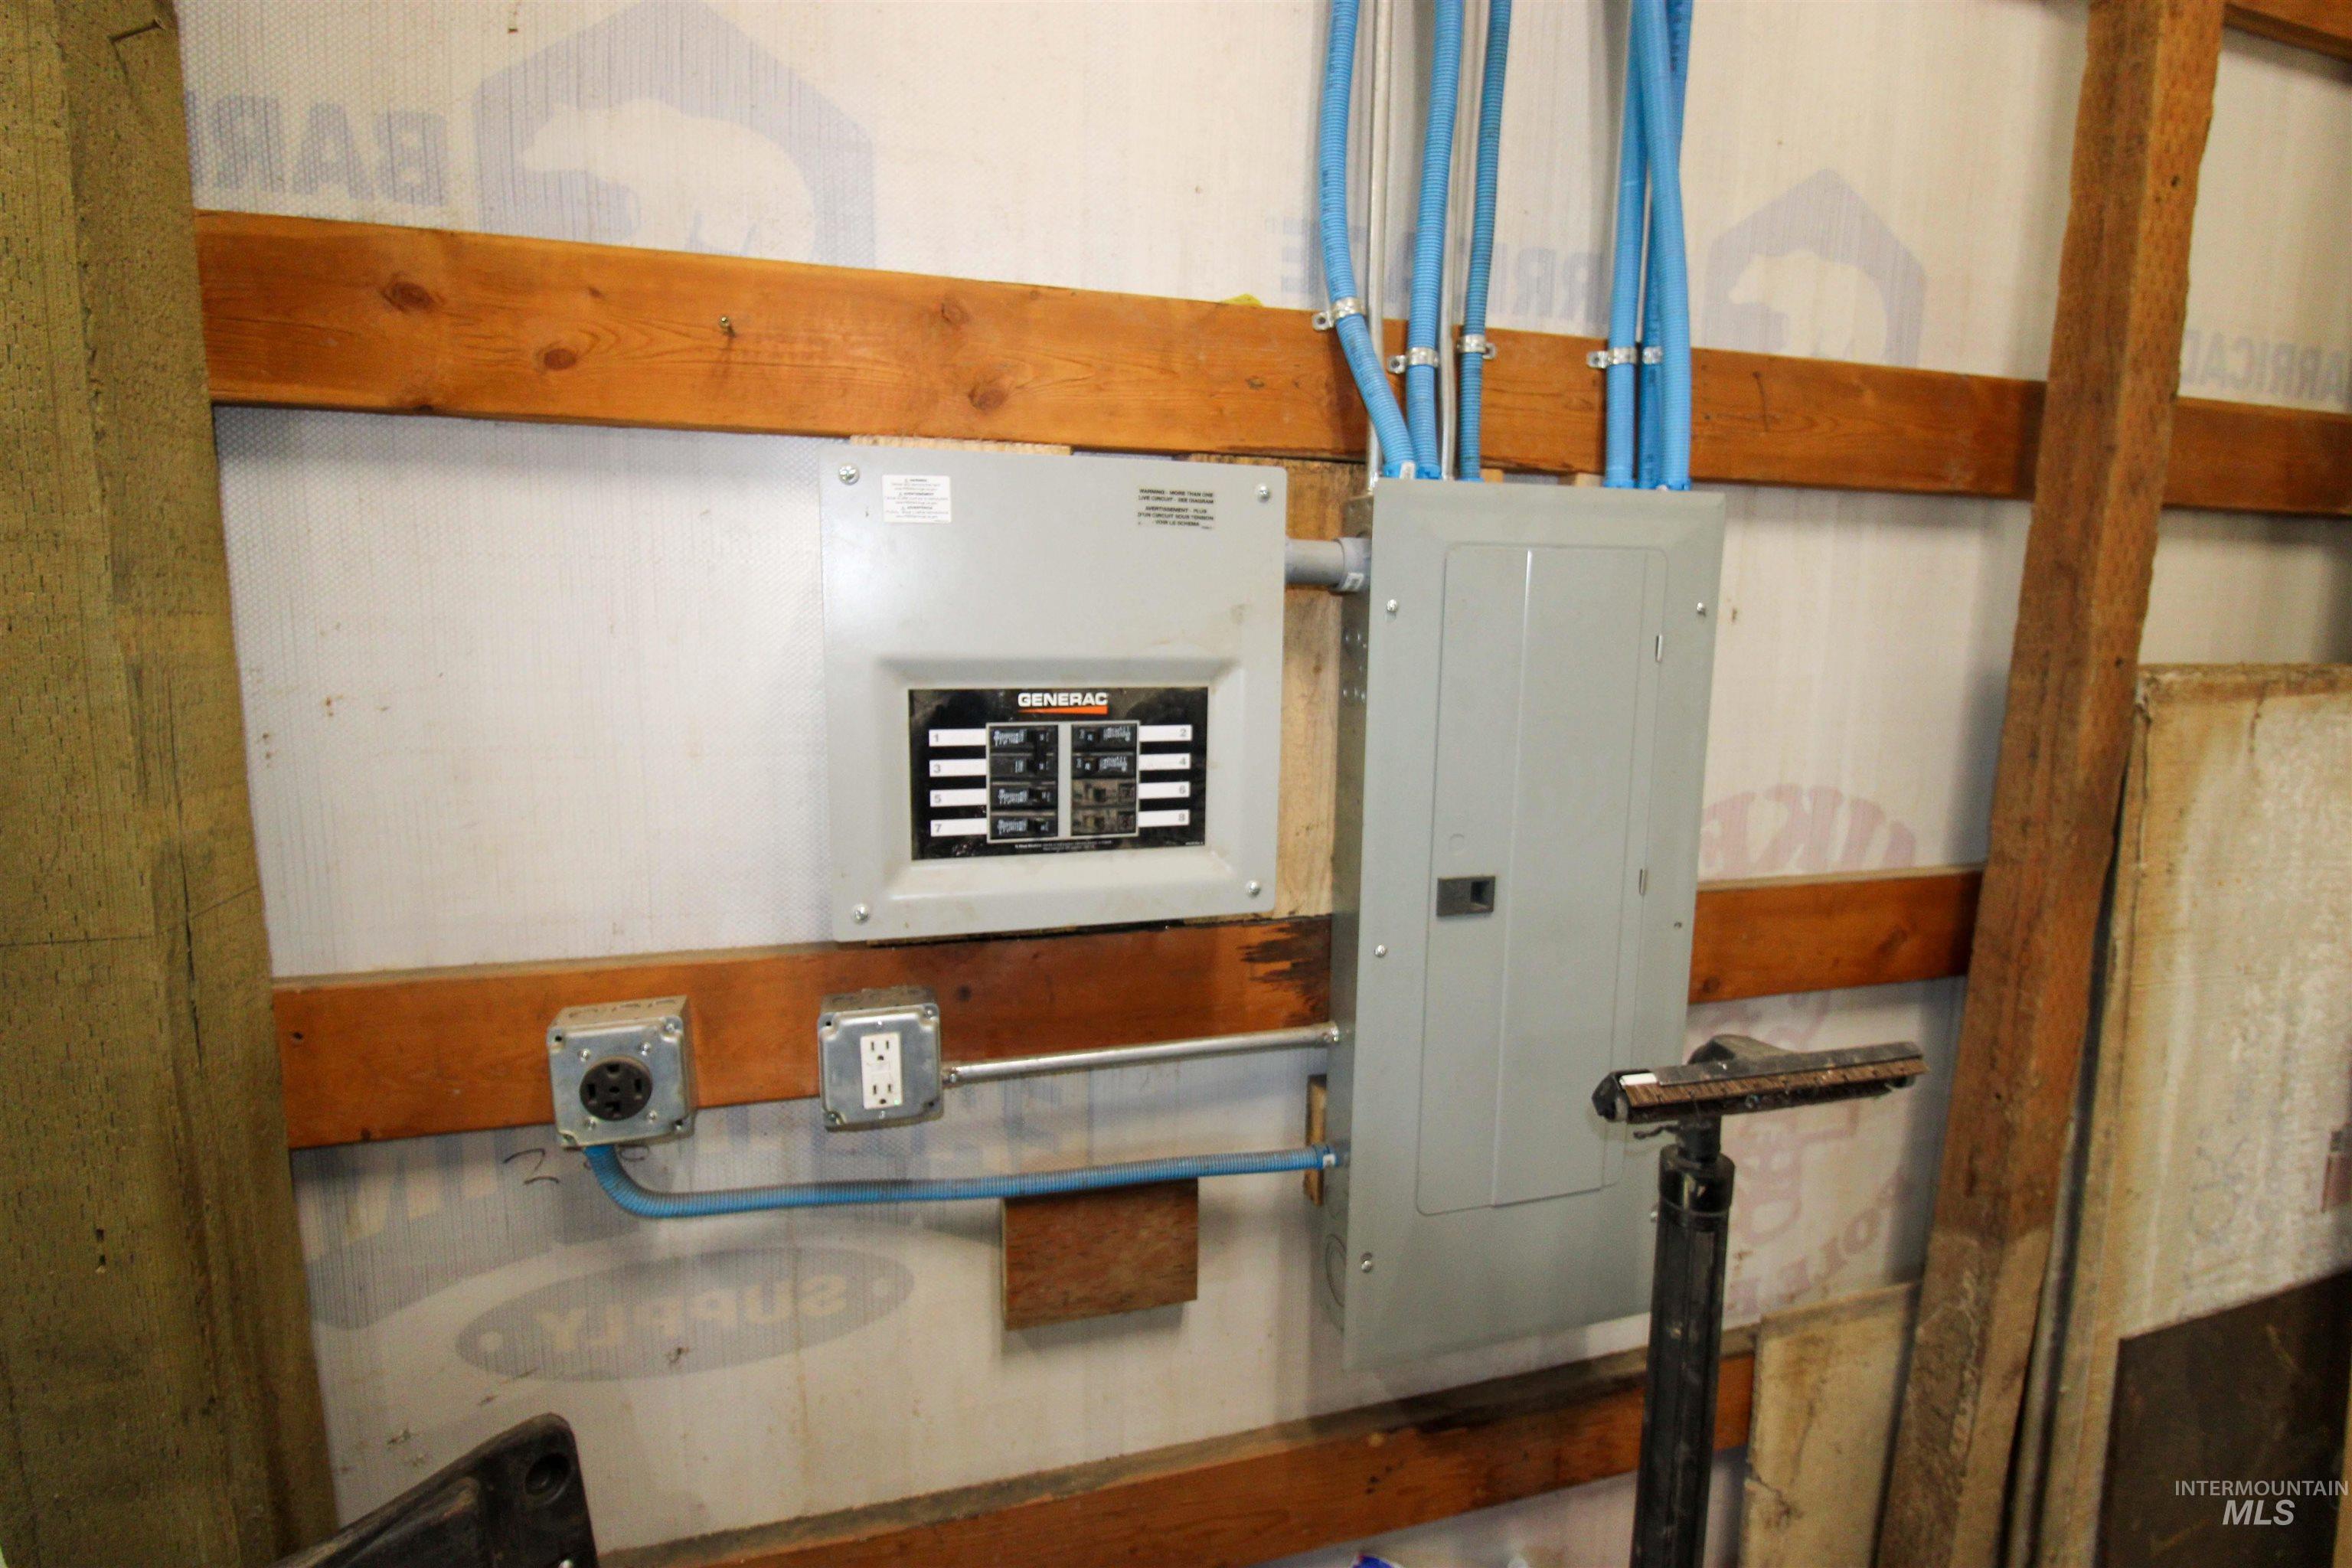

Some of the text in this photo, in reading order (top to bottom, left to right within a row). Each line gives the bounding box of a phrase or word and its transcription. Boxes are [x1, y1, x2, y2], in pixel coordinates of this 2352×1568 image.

[1018, 692, 1109, 707] GENERAC
[1180, 728, 1187, 737] 2
[933, 734, 939, 743] 1
[1179, 758, 1187, 766] 4
[933, 764, 941, 773] 3
[1179, 786, 1186, 794] 6
[934, 795, 942, 803] 5
[935, 824, 942, 833] 7
